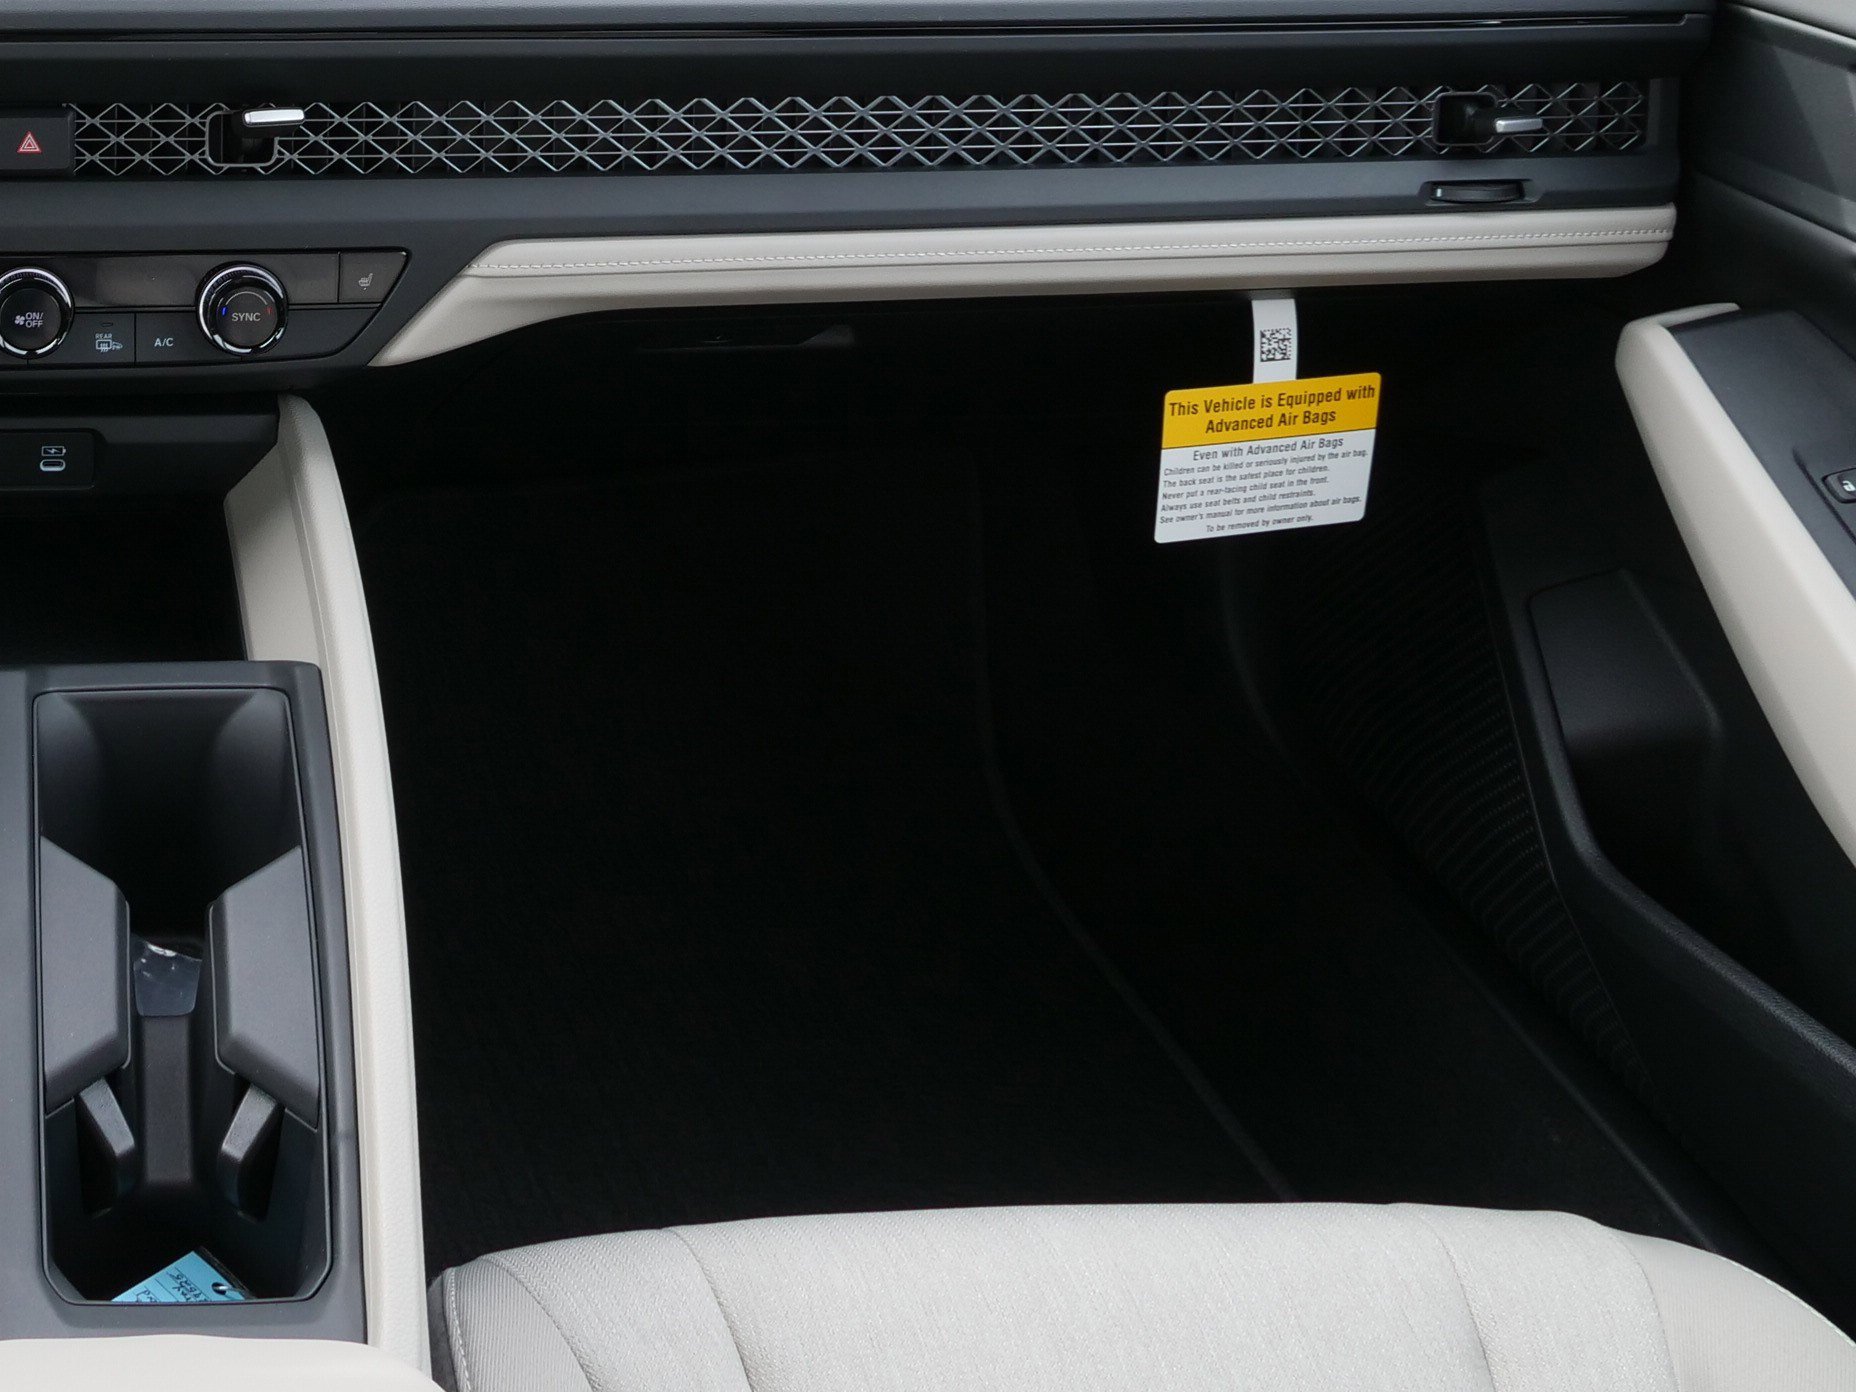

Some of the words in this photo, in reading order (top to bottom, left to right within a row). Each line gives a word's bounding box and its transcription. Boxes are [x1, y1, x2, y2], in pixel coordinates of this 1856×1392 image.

[25, 312, 44, 321] ON/
[25, 320, 44, 329] OFF
[231, 312, 261, 323] SYNC
[154, 337, 174, 347] A/C
[1169, 402, 1199, 416] This
[1204, 396, 1256, 413] Vehicle
[1261, 395, 1273, 408] is
[1277, 388, 1342, 408] Equipped
[1346, 385, 1375, 400] with
[1205, 414, 1274, 434] Advanced
[1277, 412, 1299, 427] Air
[1302, 410, 1336, 426] Bags
[1193, 450, 1218, 461] Even
[1221, 447, 1243, 458] with
[1246, 441, 1297, 456] Advanced
[1300, 440, 1315, 450] Air
[1318, 438, 1344, 449] Bags
[1164, 467, 1195, 476] Children
[1223, 462, 1243, 470] killed
[1255, 457, 1288, 467] seriously
[1289, 454, 1315, 463] injured
[1317, 453, 1326, 462] by
[1327, 452, 1339, 460] the
[1163, 480, 1177, 488] The
[1179, 478, 1196, 486] back
[1198, 477, 1214, 485] seat
[1217, 475, 1223, 483] is
[1225, 474, 1237, 482] the
[1238, 471, 1262, 481] safest
[1263, 470, 1283, 479] place
[1162, 492, 1184, 500] Never
[1186, 490, 1198, 499] put
[1206, 485, 1248, 495] rear-facing
[1249, 482, 1267, 491] child
[1269, 480, 1286, 489] seat
[1296, 478, 1308, 486] the
[1159, 515, 1174, 524] See
[1175, 513, 1203, 522] owner's
[1205, 510, 1232, 519] manual
[1234, 508, 1245, 516] for
[1246, 507, 1265, 515] more
[1266, 502, 1308, 512] information
[1309, 498, 1330, 508] about
[1331, 497, 1341, 505] air
[1161, 503, 1187, 512] Always
[1205, 499, 1221, 508] seat
[1222, 497, 1241, 506] belts
[1243, 495, 1257, 503] and
[1258, 493, 1276, 501] child
[1206, 525, 1214, 533] To
[1228, 520, 1259, 530] removed
[1261, 519, 1270, 527] by
[1272, 517, 1295, 525] owner
